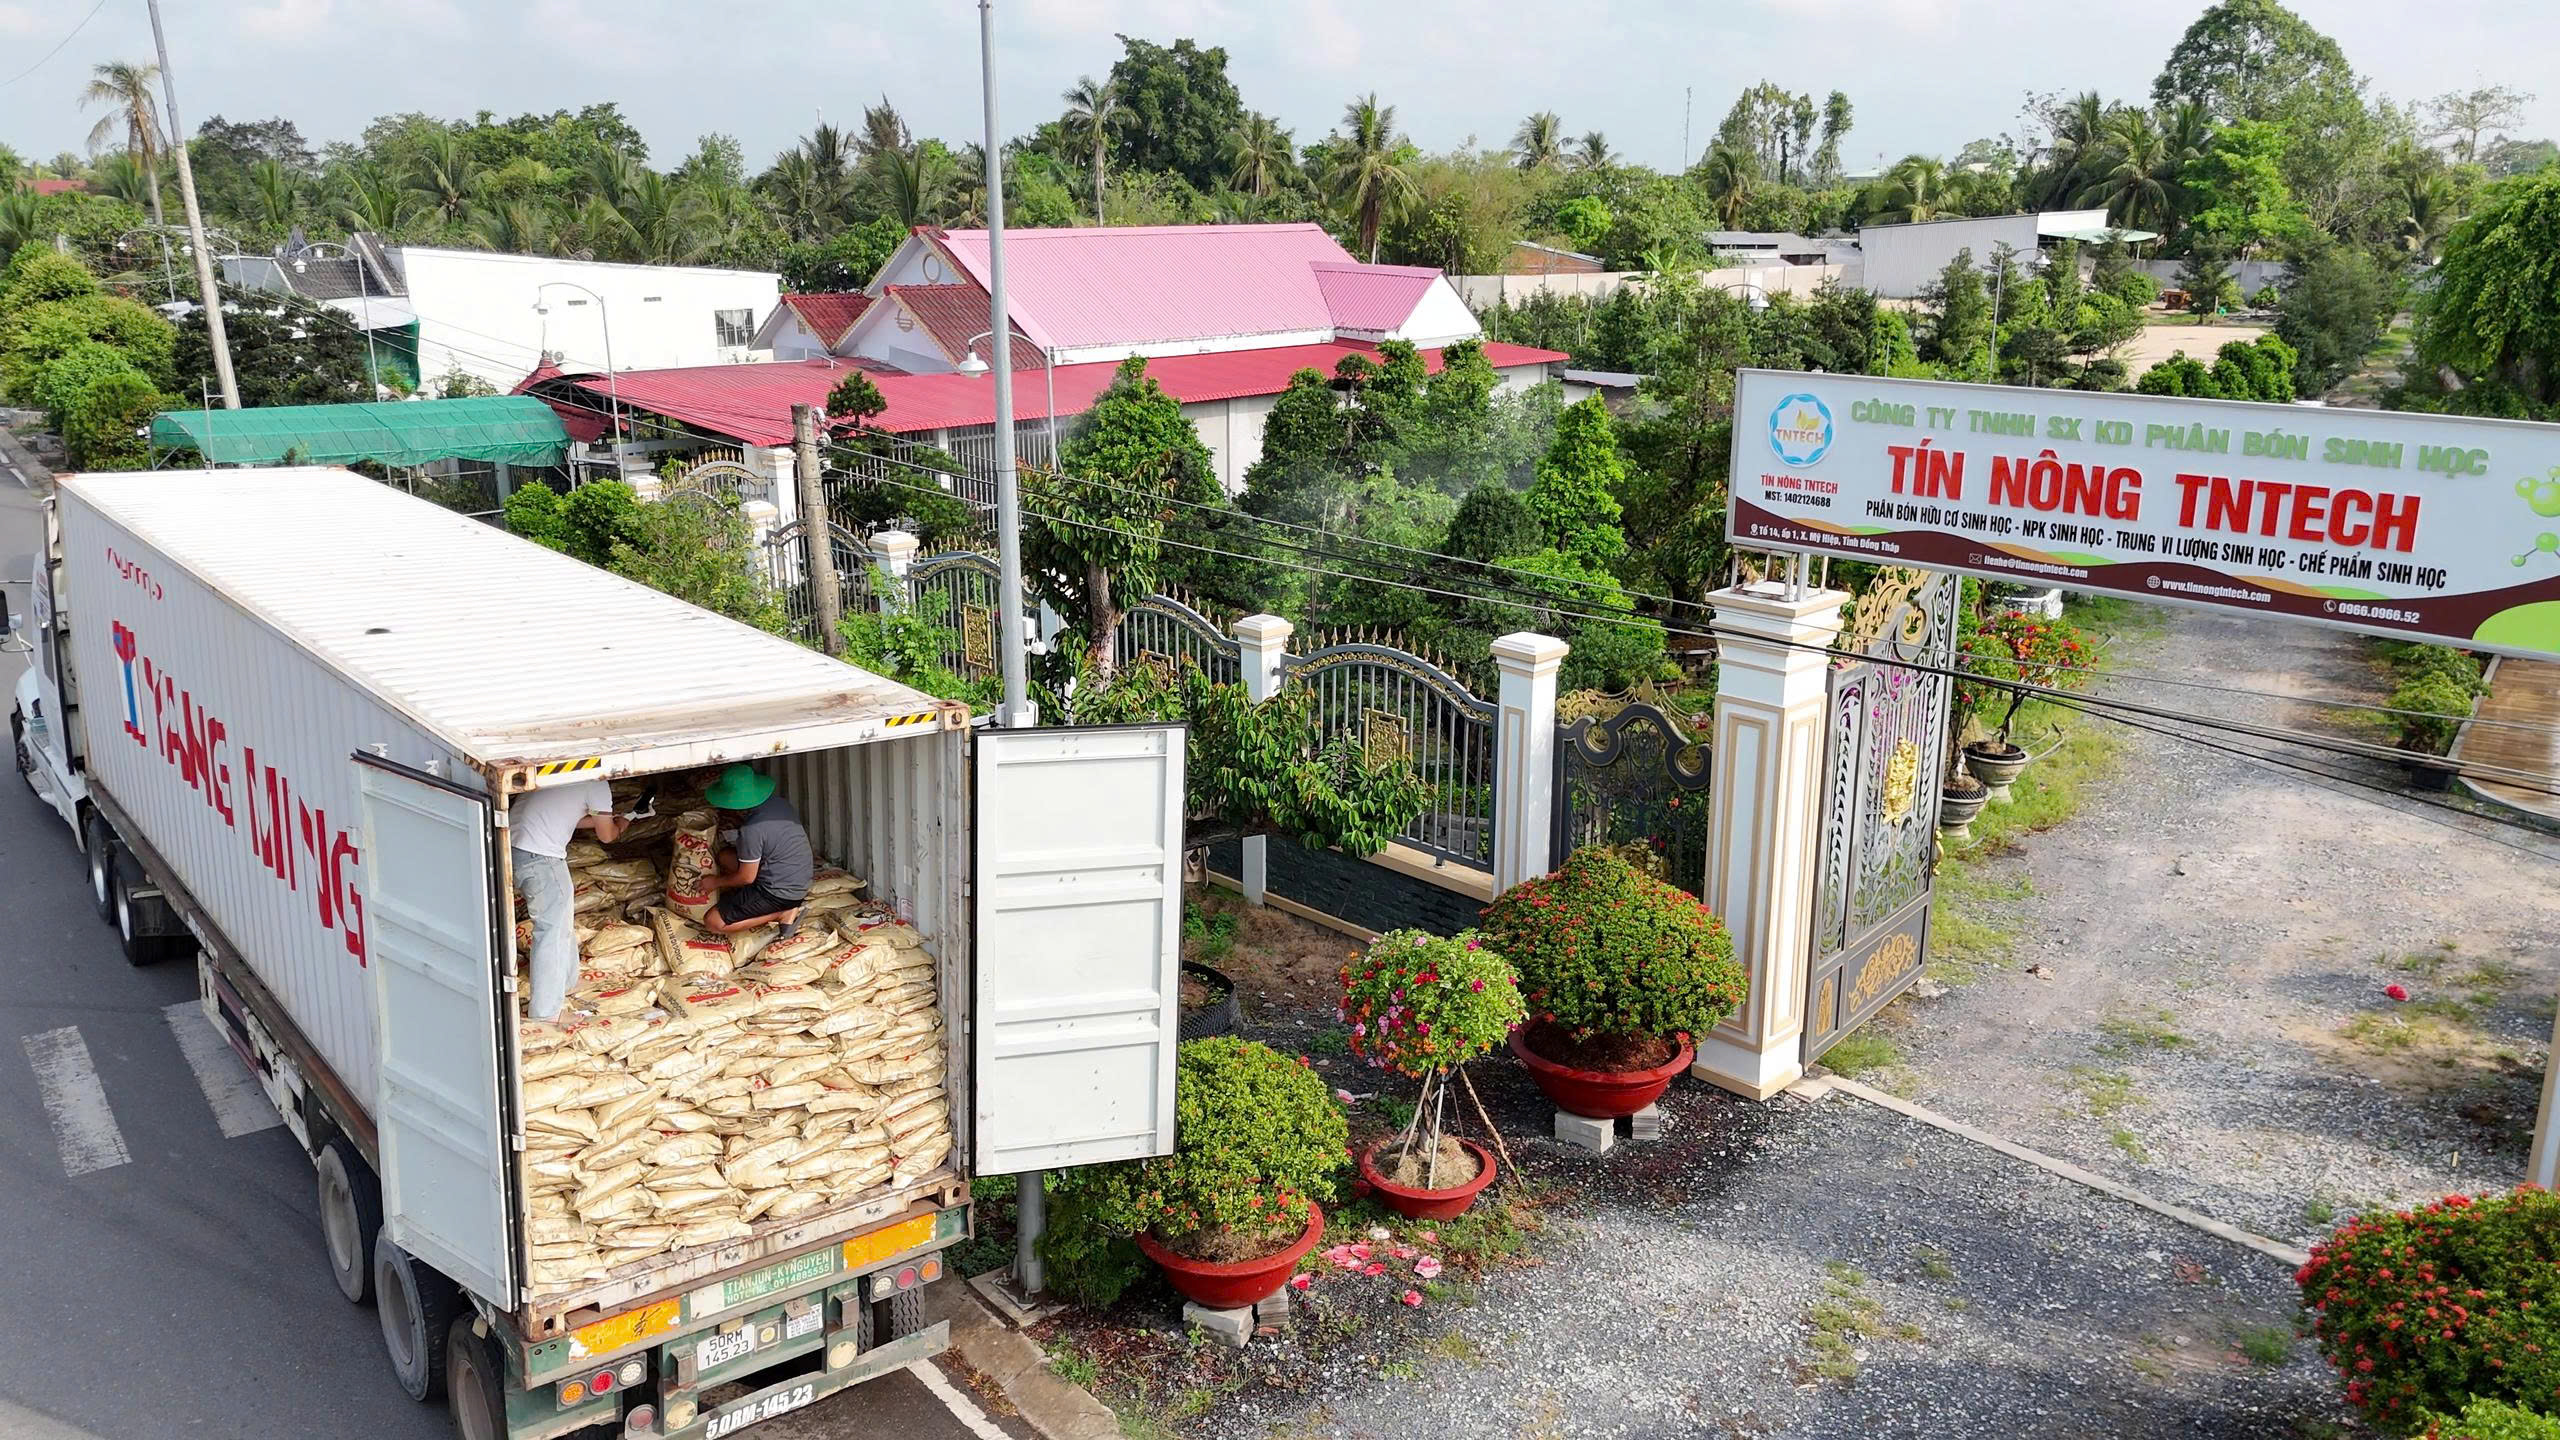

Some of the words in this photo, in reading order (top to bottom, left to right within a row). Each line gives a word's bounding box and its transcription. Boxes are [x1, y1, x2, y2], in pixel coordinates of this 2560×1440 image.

[1776, 429, 1825, 444] TNTECH
[1851, 398, 1916, 427] CÔNG
[1926, 407, 1956, 431] TY
[1967, 409, 2036, 438] TNHH
[2046, 415, 2084, 441] SX
[2094, 419, 2134, 446] KD
[2145, 422, 2231, 455] PHÂN
[2242, 427, 2310, 461] BÓN
[2323, 437, 2404, 469] SINH
[2417, 444, 2489, 479] HỌC
[1760, 473, 1775, 487] TÍN
[1777, 475, 1802, 490] NÔNG
[1804, 479, 1839, 494] TNTECH
[1887, 438, 1965, 501] TÍN
[1988, 448, 2143, 522] NÔNG
[2175, 474, 2421, 553] TNTECH
[1764, 490, 1783, 501] MST:
[1784, 493, 1831, 508] 1402124688
[1800, 530, 1808, 541] X.
[1866, 499, 1894, 519] PHÂN
[1896, 502, 1918, 522] BÓN
[1920, 505, 1941, 525] HỮU
[1944, 509, 1960, 528] CƠ
[1961, 512, 1988, 532] SINH
[1990, 515, 2012, 536] HỌC
[2022, 519, 2047, 539] NPK
[2049, 523, 2078, 543] SINH
[2080, 526, 2104, 548] HỌC
[2116, 530, 2156, 553] TRUNG
[2162, 536, 2174, 555] VI
[2176, 537, 2219, 562] LƯỢNG
[2221, 543, 2254, 565] SINH
[2258, 547, 2286, 571] HỌC
[2298, 549, 2329, 574] CHẾ
[2329, 551, 2373, 580] PHẨM
[2377, 561, 2413, 585] SINH
[2415, 566, 2447, 591] HỌC
[2338, 602, 2420, 624] 0966.0966.52
[143, 656, 235, 833] YANG
[244, 746, 367, 968] MING
[709, 1329, 743, 1352] 50RM
[705, 1340, 749, 1366] 145.23
[705, 1384, 814, 1440] 50RM-145.23
